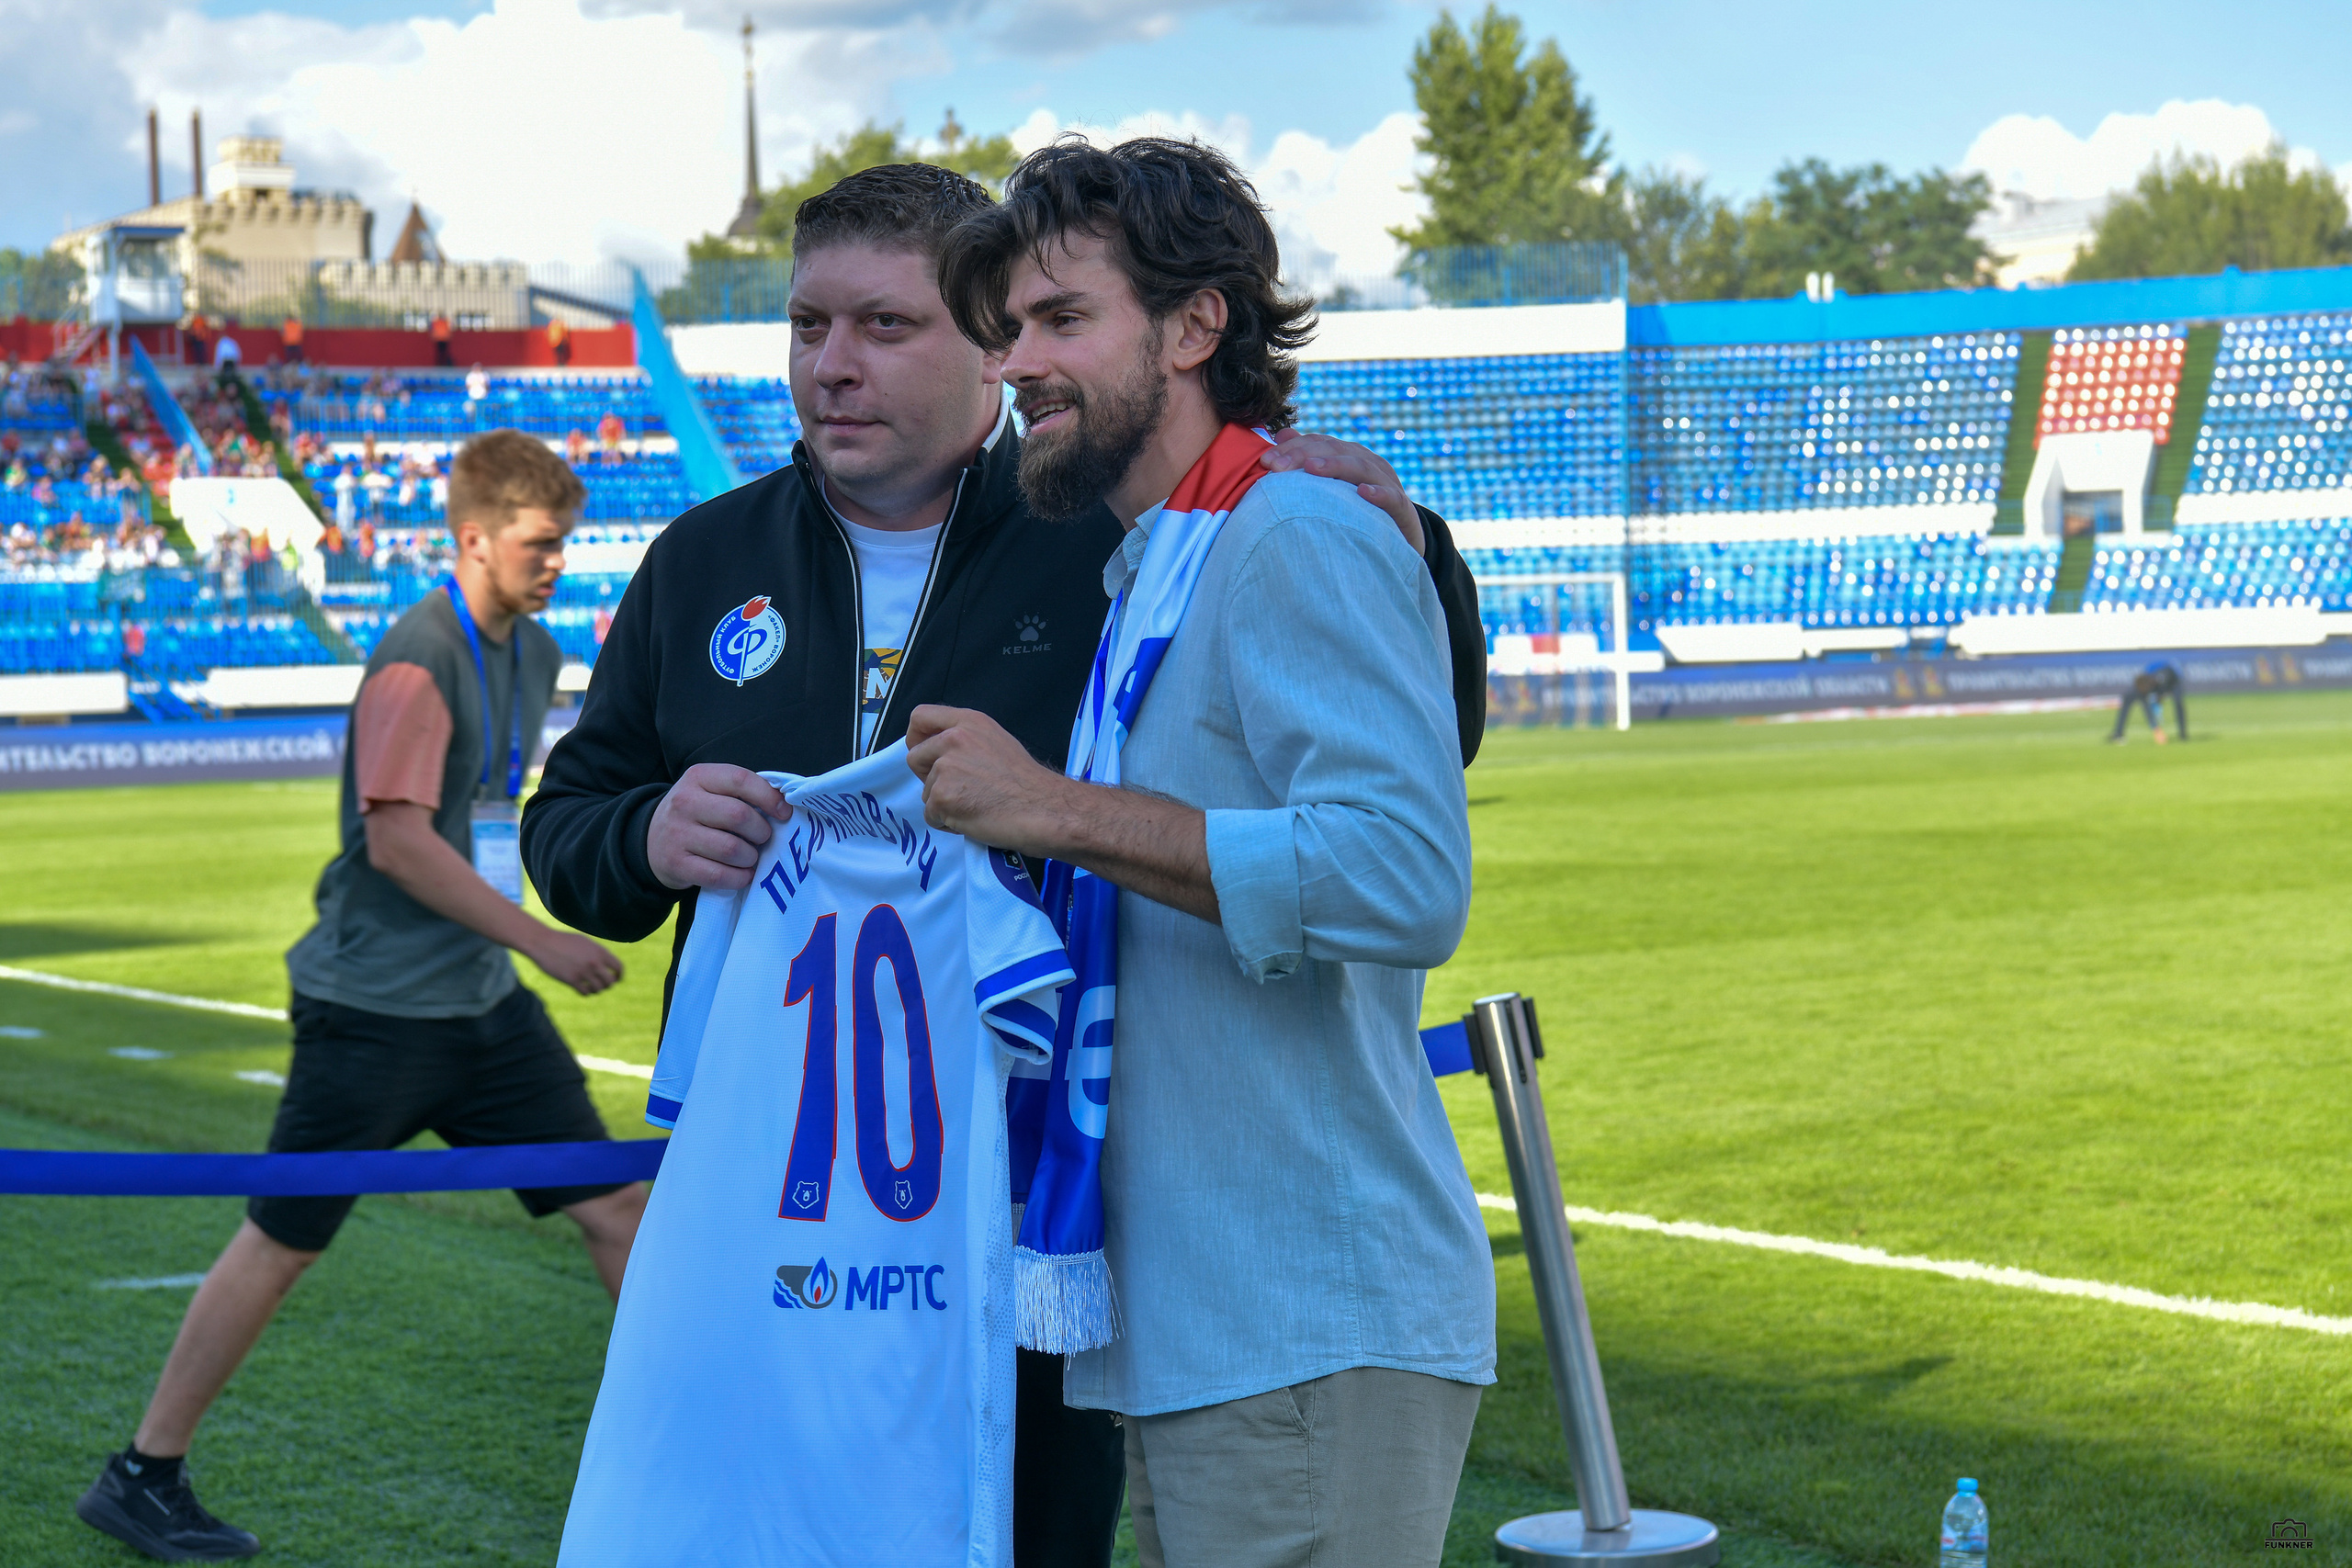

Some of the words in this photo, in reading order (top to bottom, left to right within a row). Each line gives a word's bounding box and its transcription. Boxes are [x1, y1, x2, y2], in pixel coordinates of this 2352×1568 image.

[719, 615, 737, 633] КЛУБ
[715, 633, 735, 674] ФУТБОЛЬНЫЙ
[752, 644, 779, 672] ВОРОНЕЖ
[1002, 643, 1052, 656] KELME
[141, 728, 334, 767] ВОРОНЕЖСКОЙ
[778, 903, 944, 1222] 10
[844, 1264, 948, 1311] МРТС
